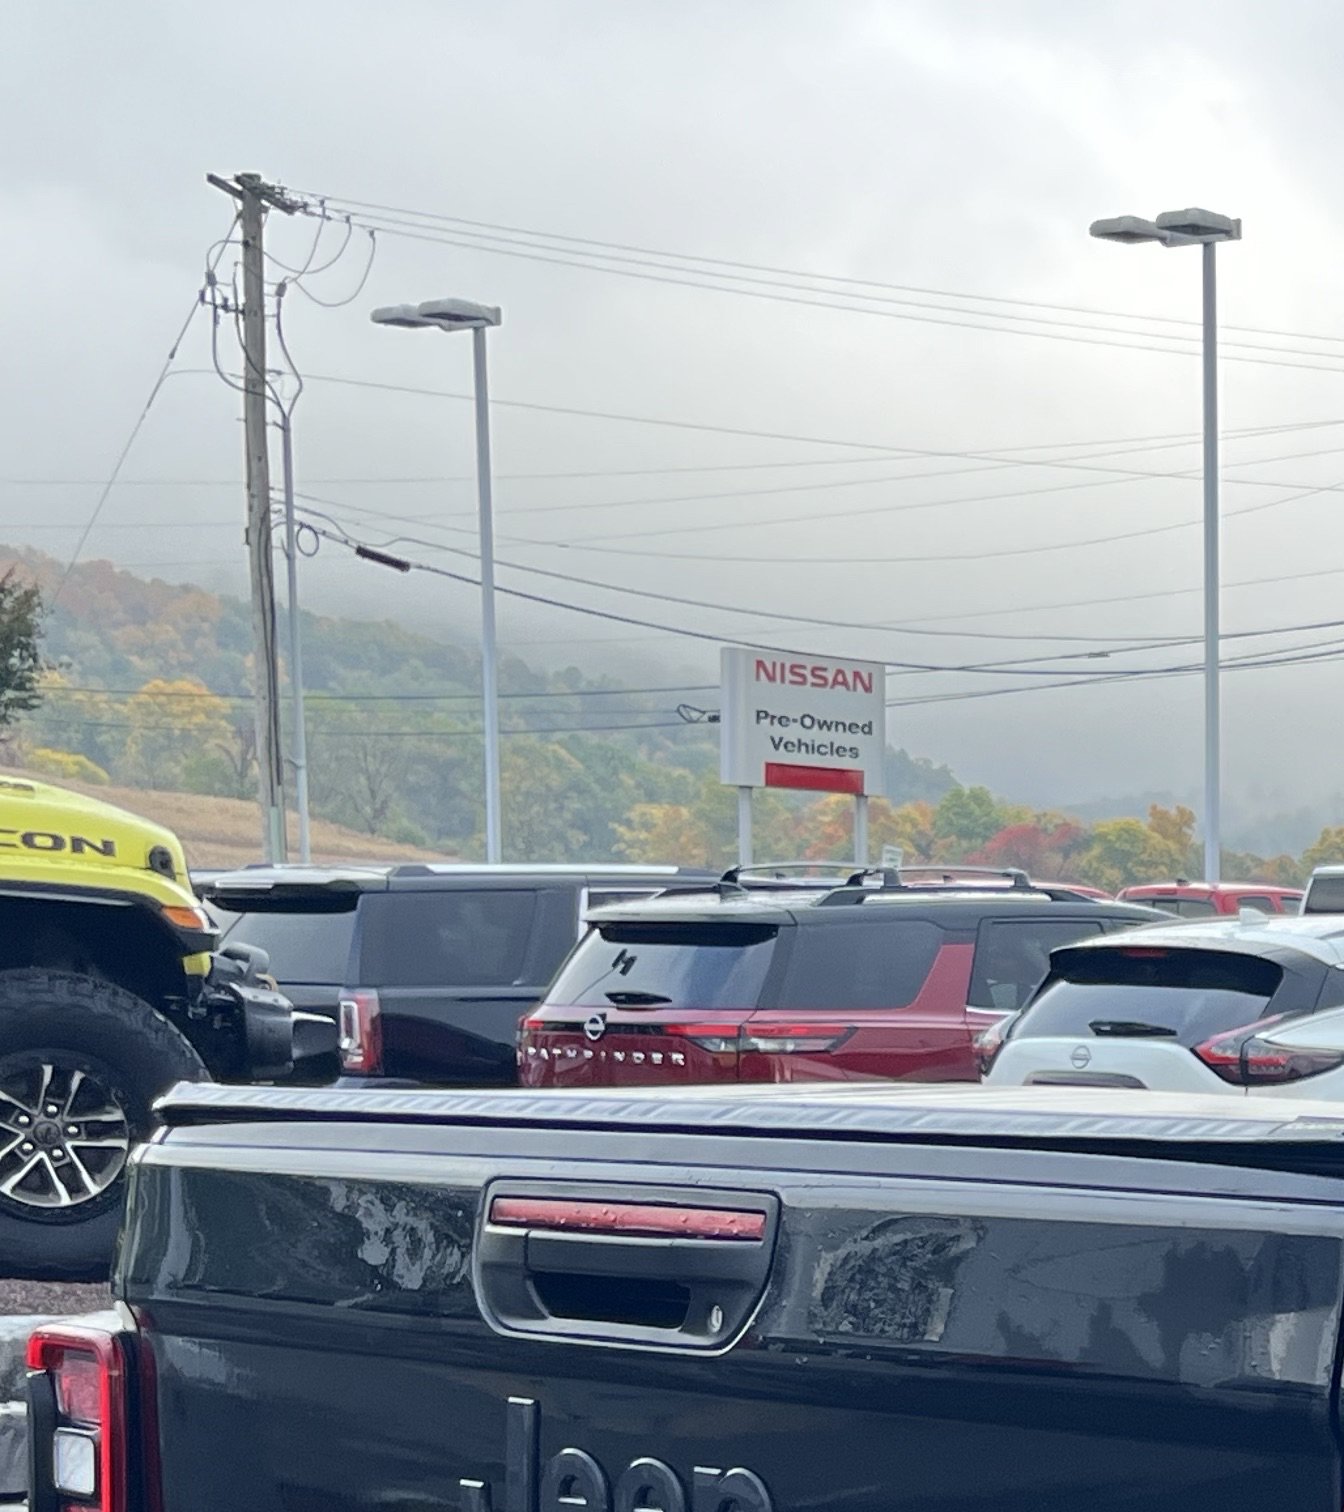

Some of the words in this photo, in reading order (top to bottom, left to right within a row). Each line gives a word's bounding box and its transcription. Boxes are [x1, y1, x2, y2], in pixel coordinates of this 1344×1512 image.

[755, 659, 873, 693] NISSAN
[756, 709, 873, 736] Pre-Owned
[770, 735, 860, 759] Vehicles
